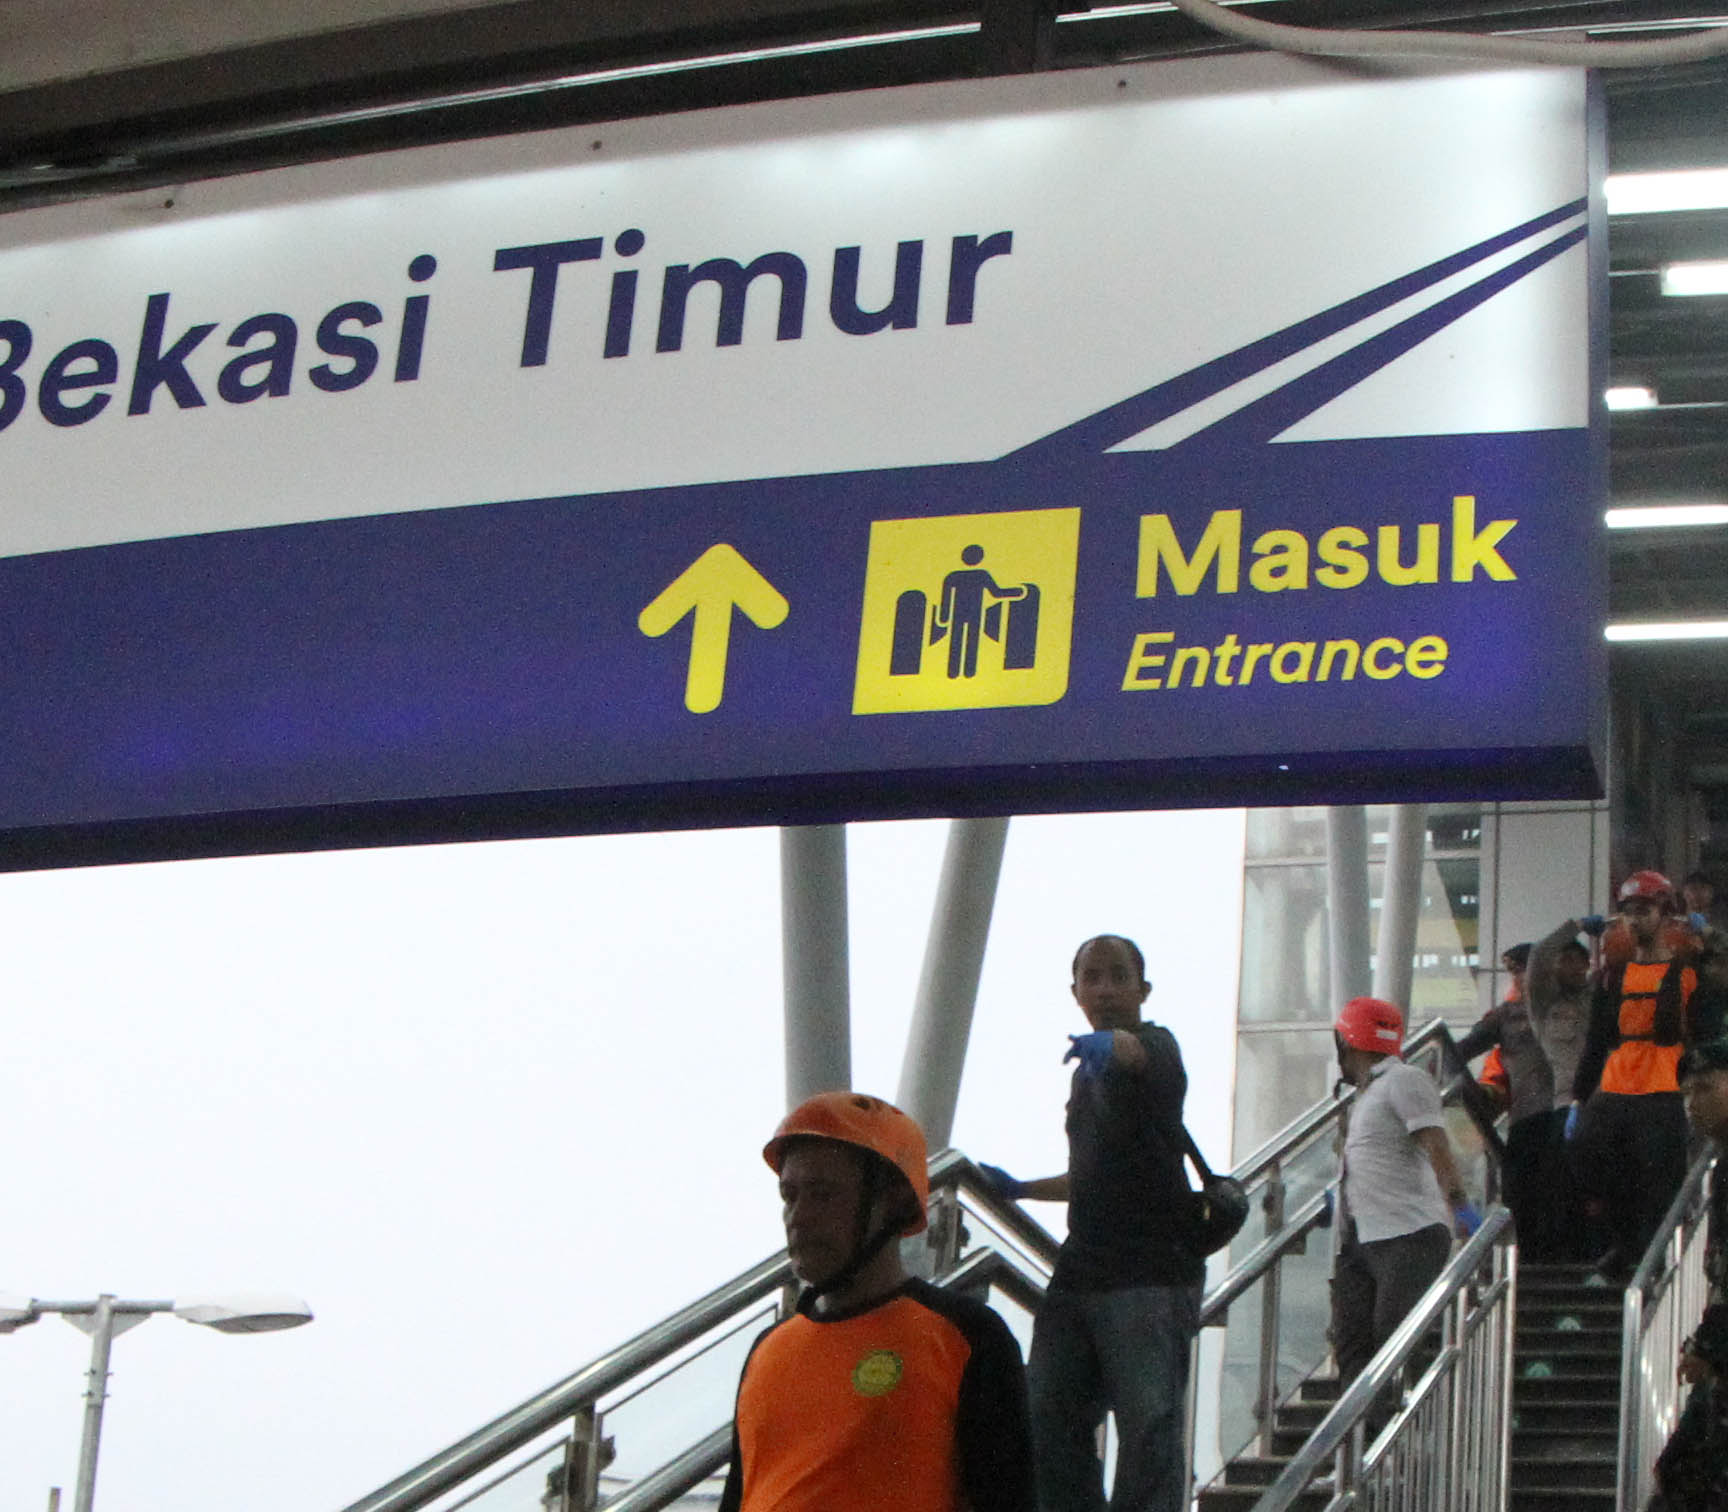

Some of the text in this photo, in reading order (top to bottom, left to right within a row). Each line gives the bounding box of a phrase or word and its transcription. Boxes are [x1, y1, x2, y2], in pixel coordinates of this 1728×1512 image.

[492, 228, 1014, 369] Timur
[1135, 495, 1518, 598] Masuk
[1121, 631, 1448, 691] Entrance
